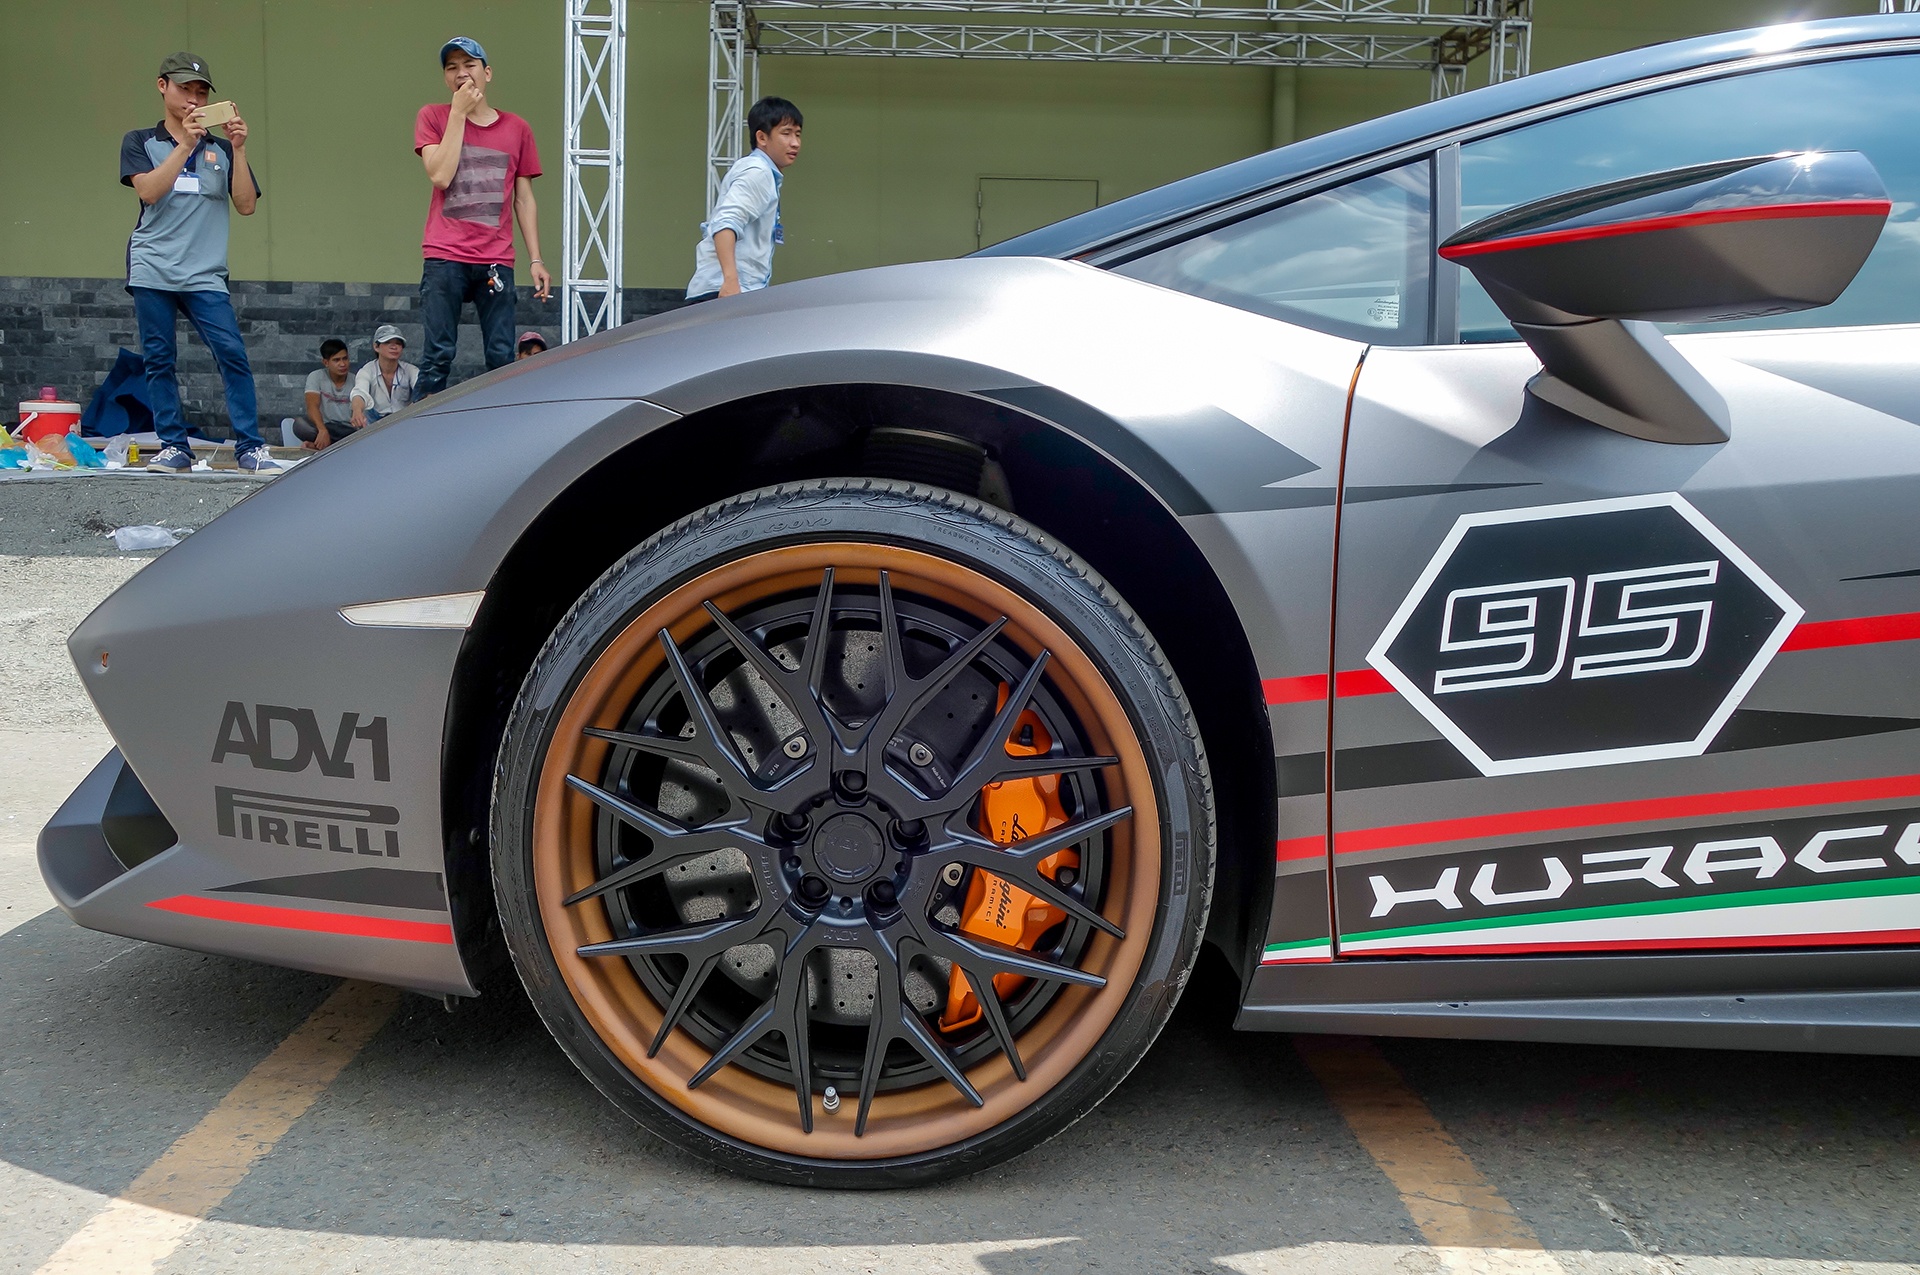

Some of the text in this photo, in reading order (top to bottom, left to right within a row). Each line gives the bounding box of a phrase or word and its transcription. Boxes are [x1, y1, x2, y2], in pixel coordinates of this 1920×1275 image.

[718, 527, 753, 548] 20
[1433, 560, 1719, 695] 95
[215, 785, 400, 858] PIRELLI
